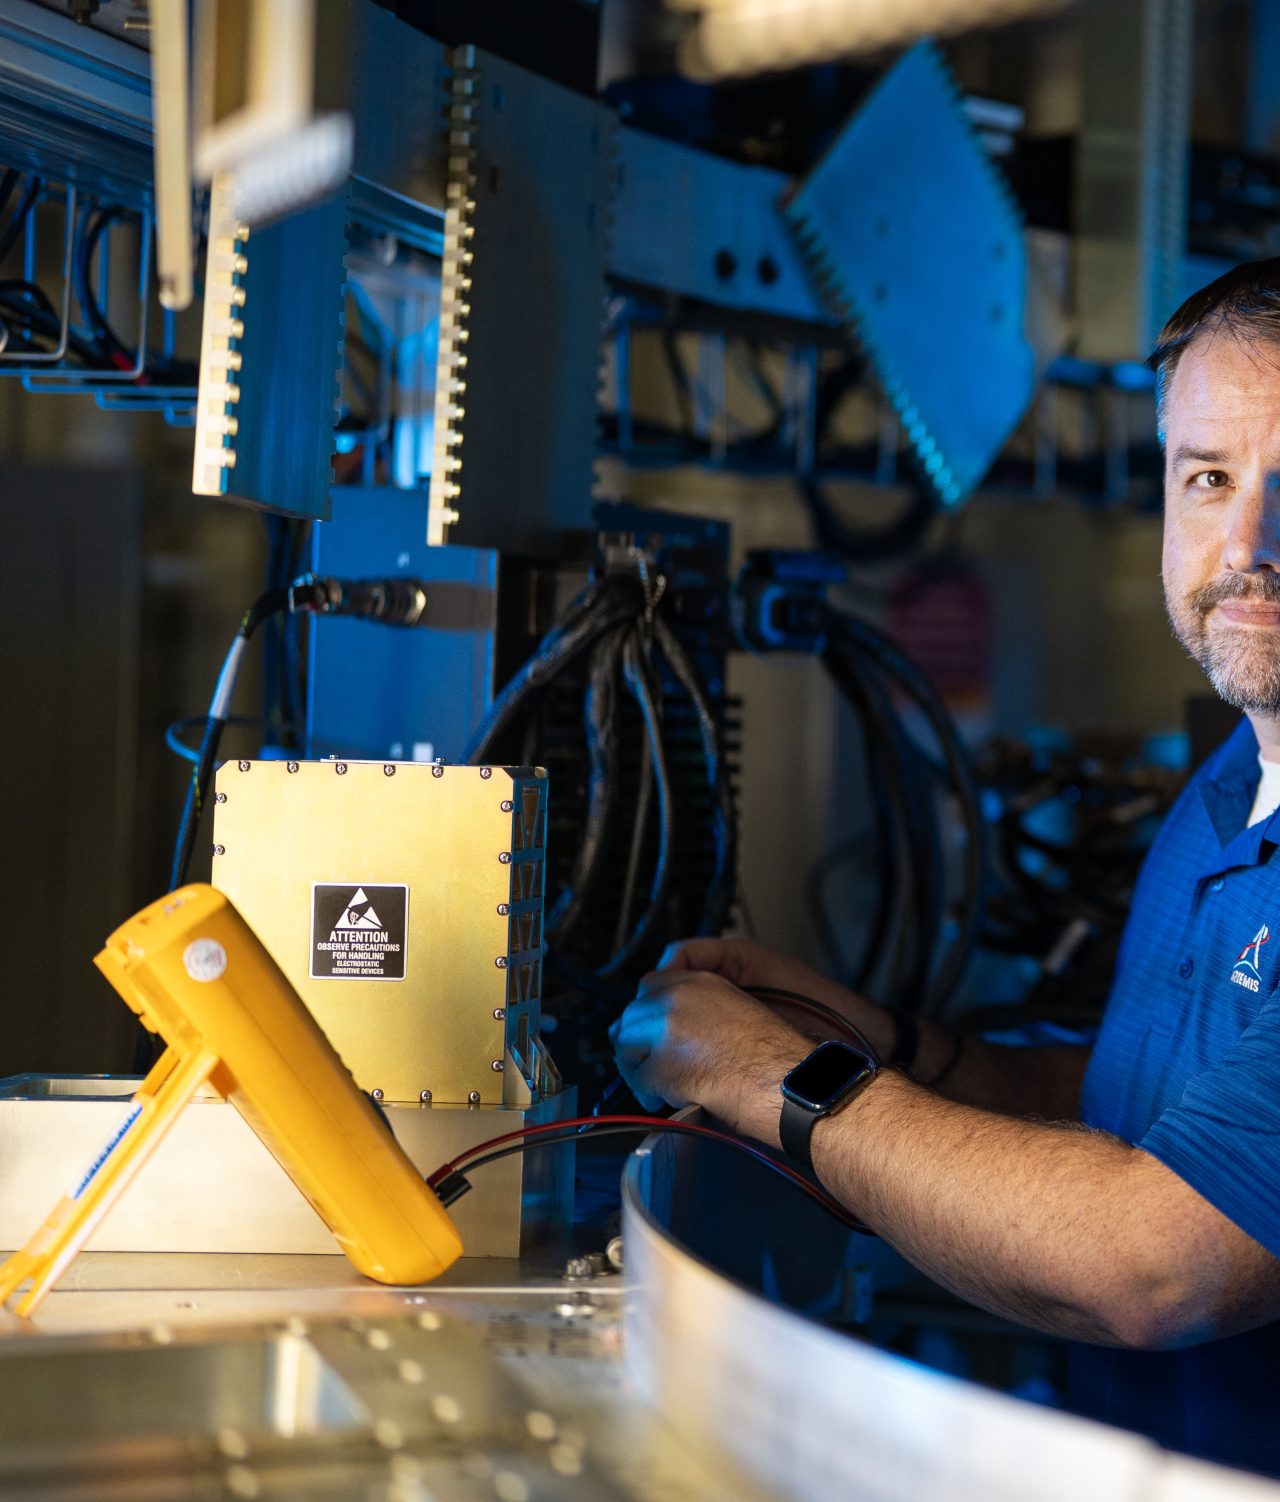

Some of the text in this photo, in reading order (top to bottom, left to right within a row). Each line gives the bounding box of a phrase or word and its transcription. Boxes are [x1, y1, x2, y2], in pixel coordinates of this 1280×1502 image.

[329, 931, 389, 943] ATTENTION
[317, 943, 400, 952] OBSERVE PRECAUTIONS
[332, 952, 385, 960] FOR HANDLING
